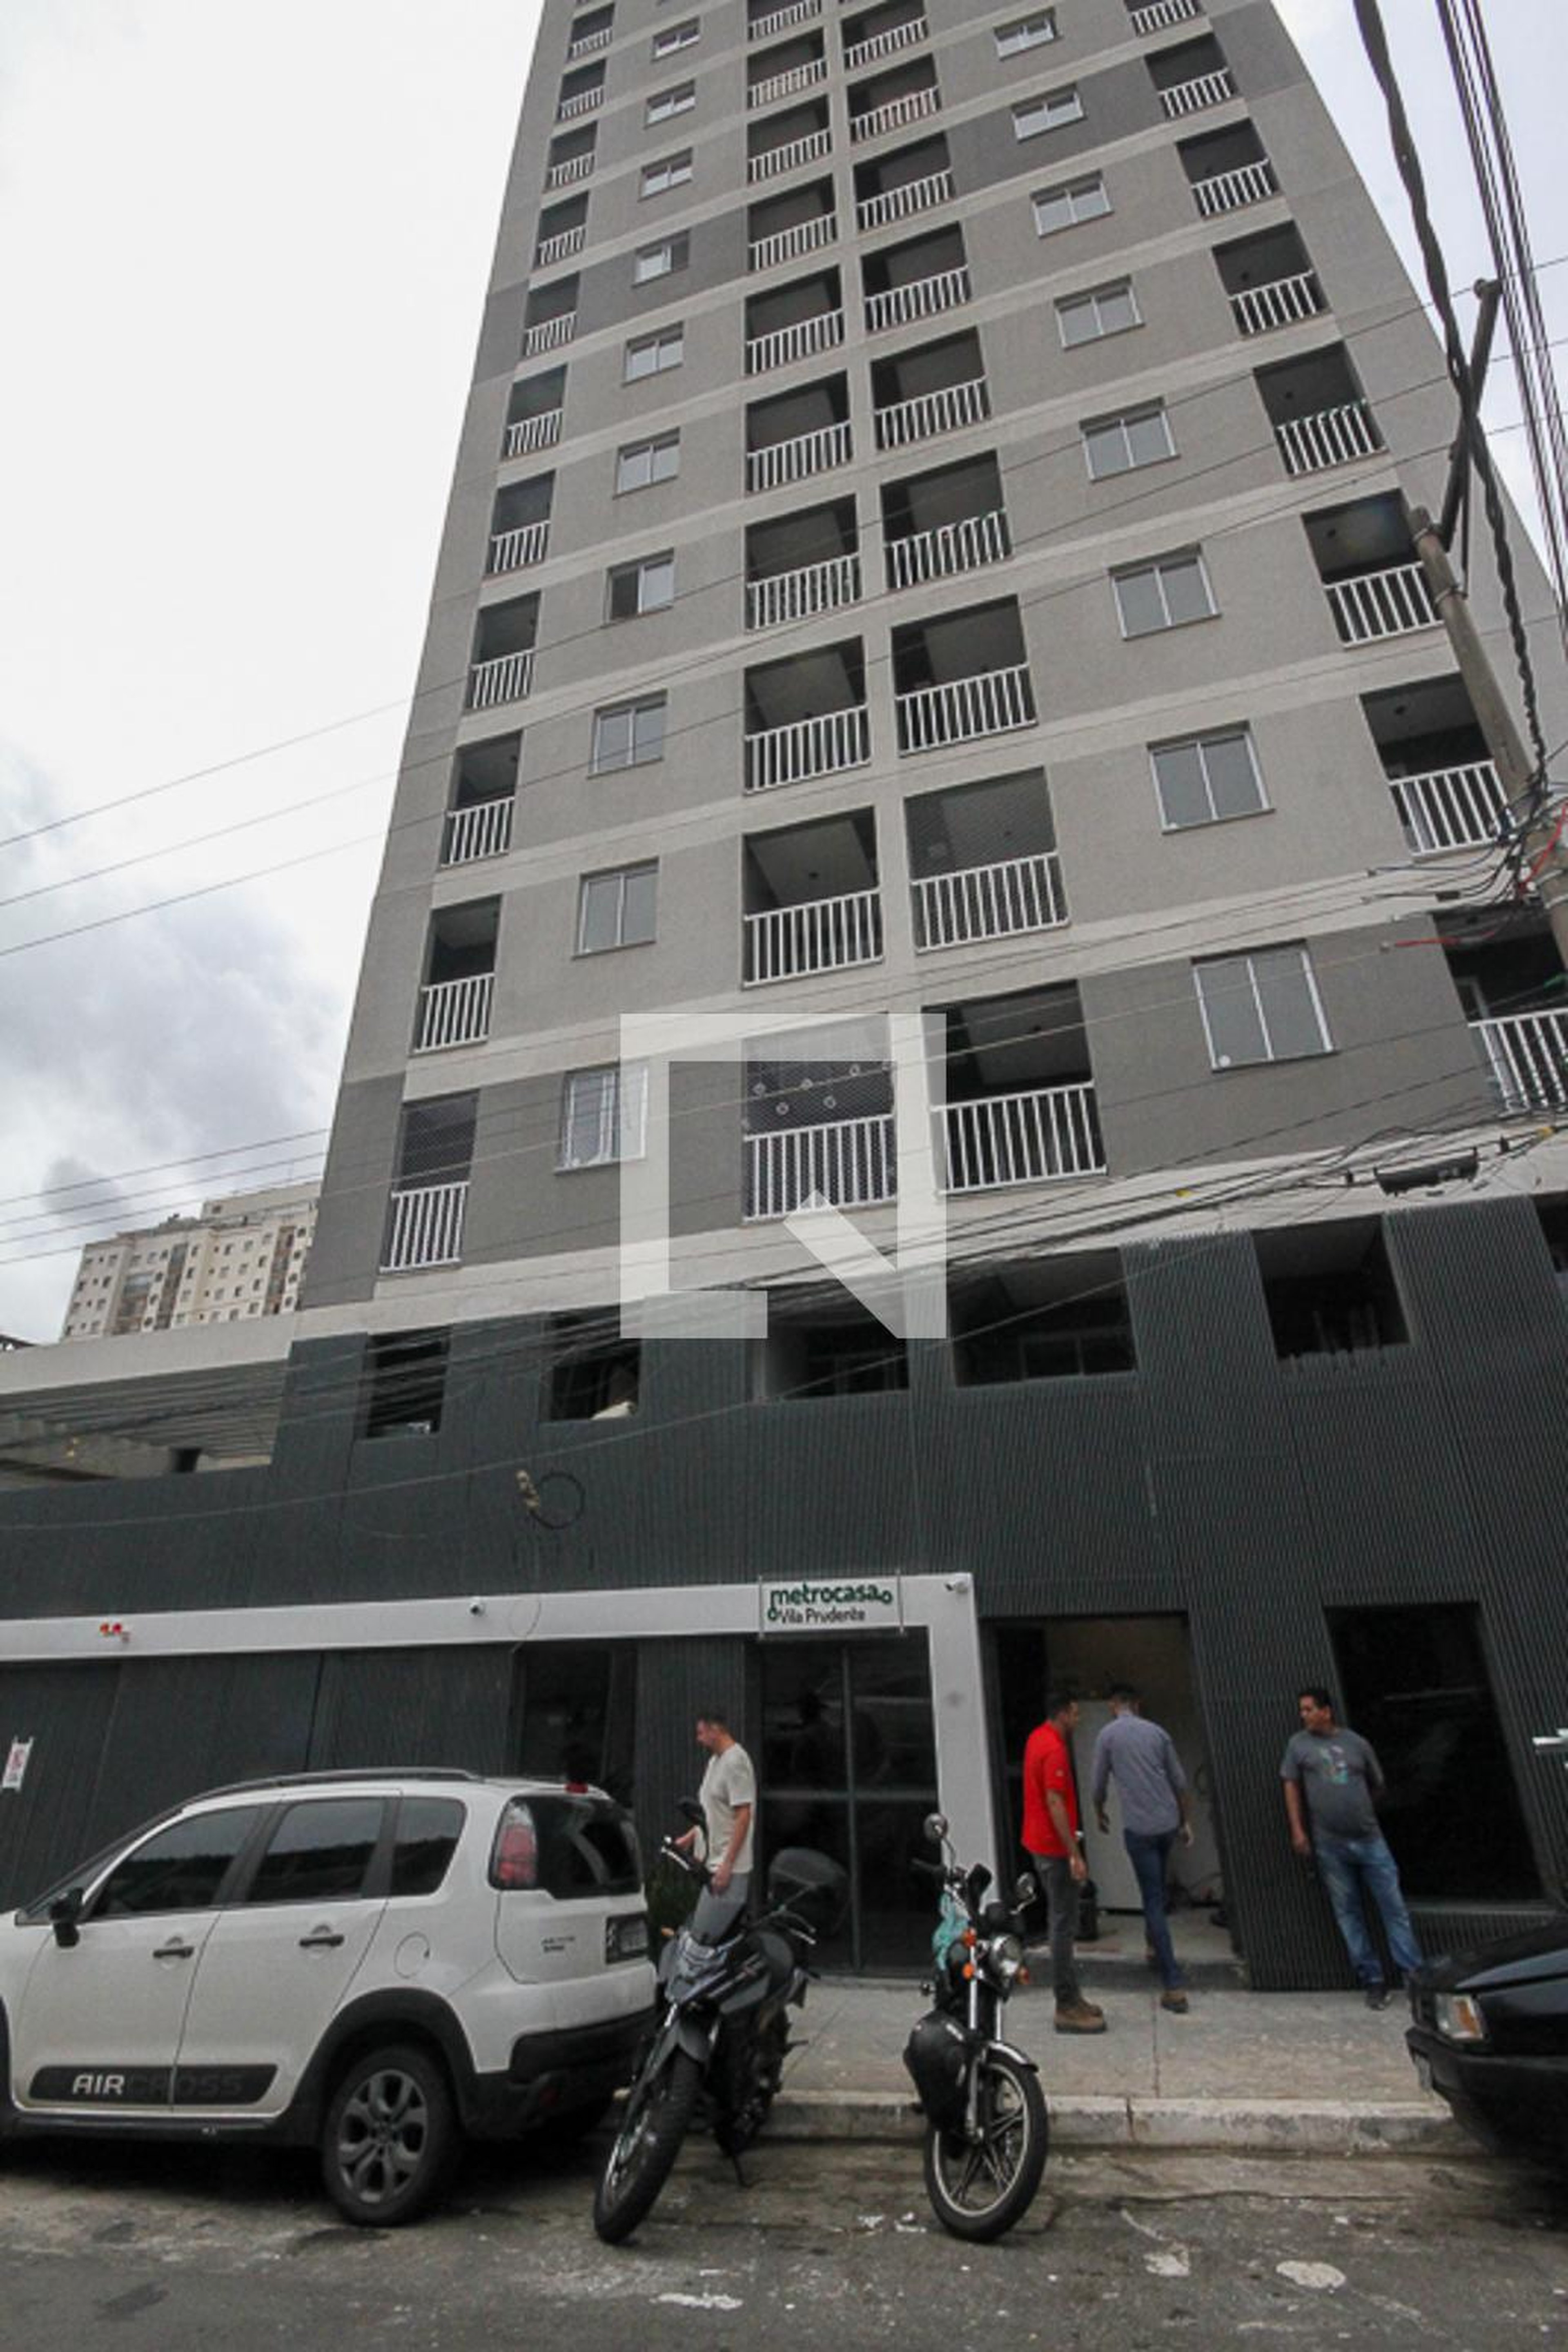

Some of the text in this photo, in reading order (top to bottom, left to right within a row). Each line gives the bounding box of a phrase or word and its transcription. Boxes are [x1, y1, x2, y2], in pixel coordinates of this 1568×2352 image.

[770, 1583, 892, 1606] metrocasa
[780, 1607, 865, 1624] Vila Prudente
